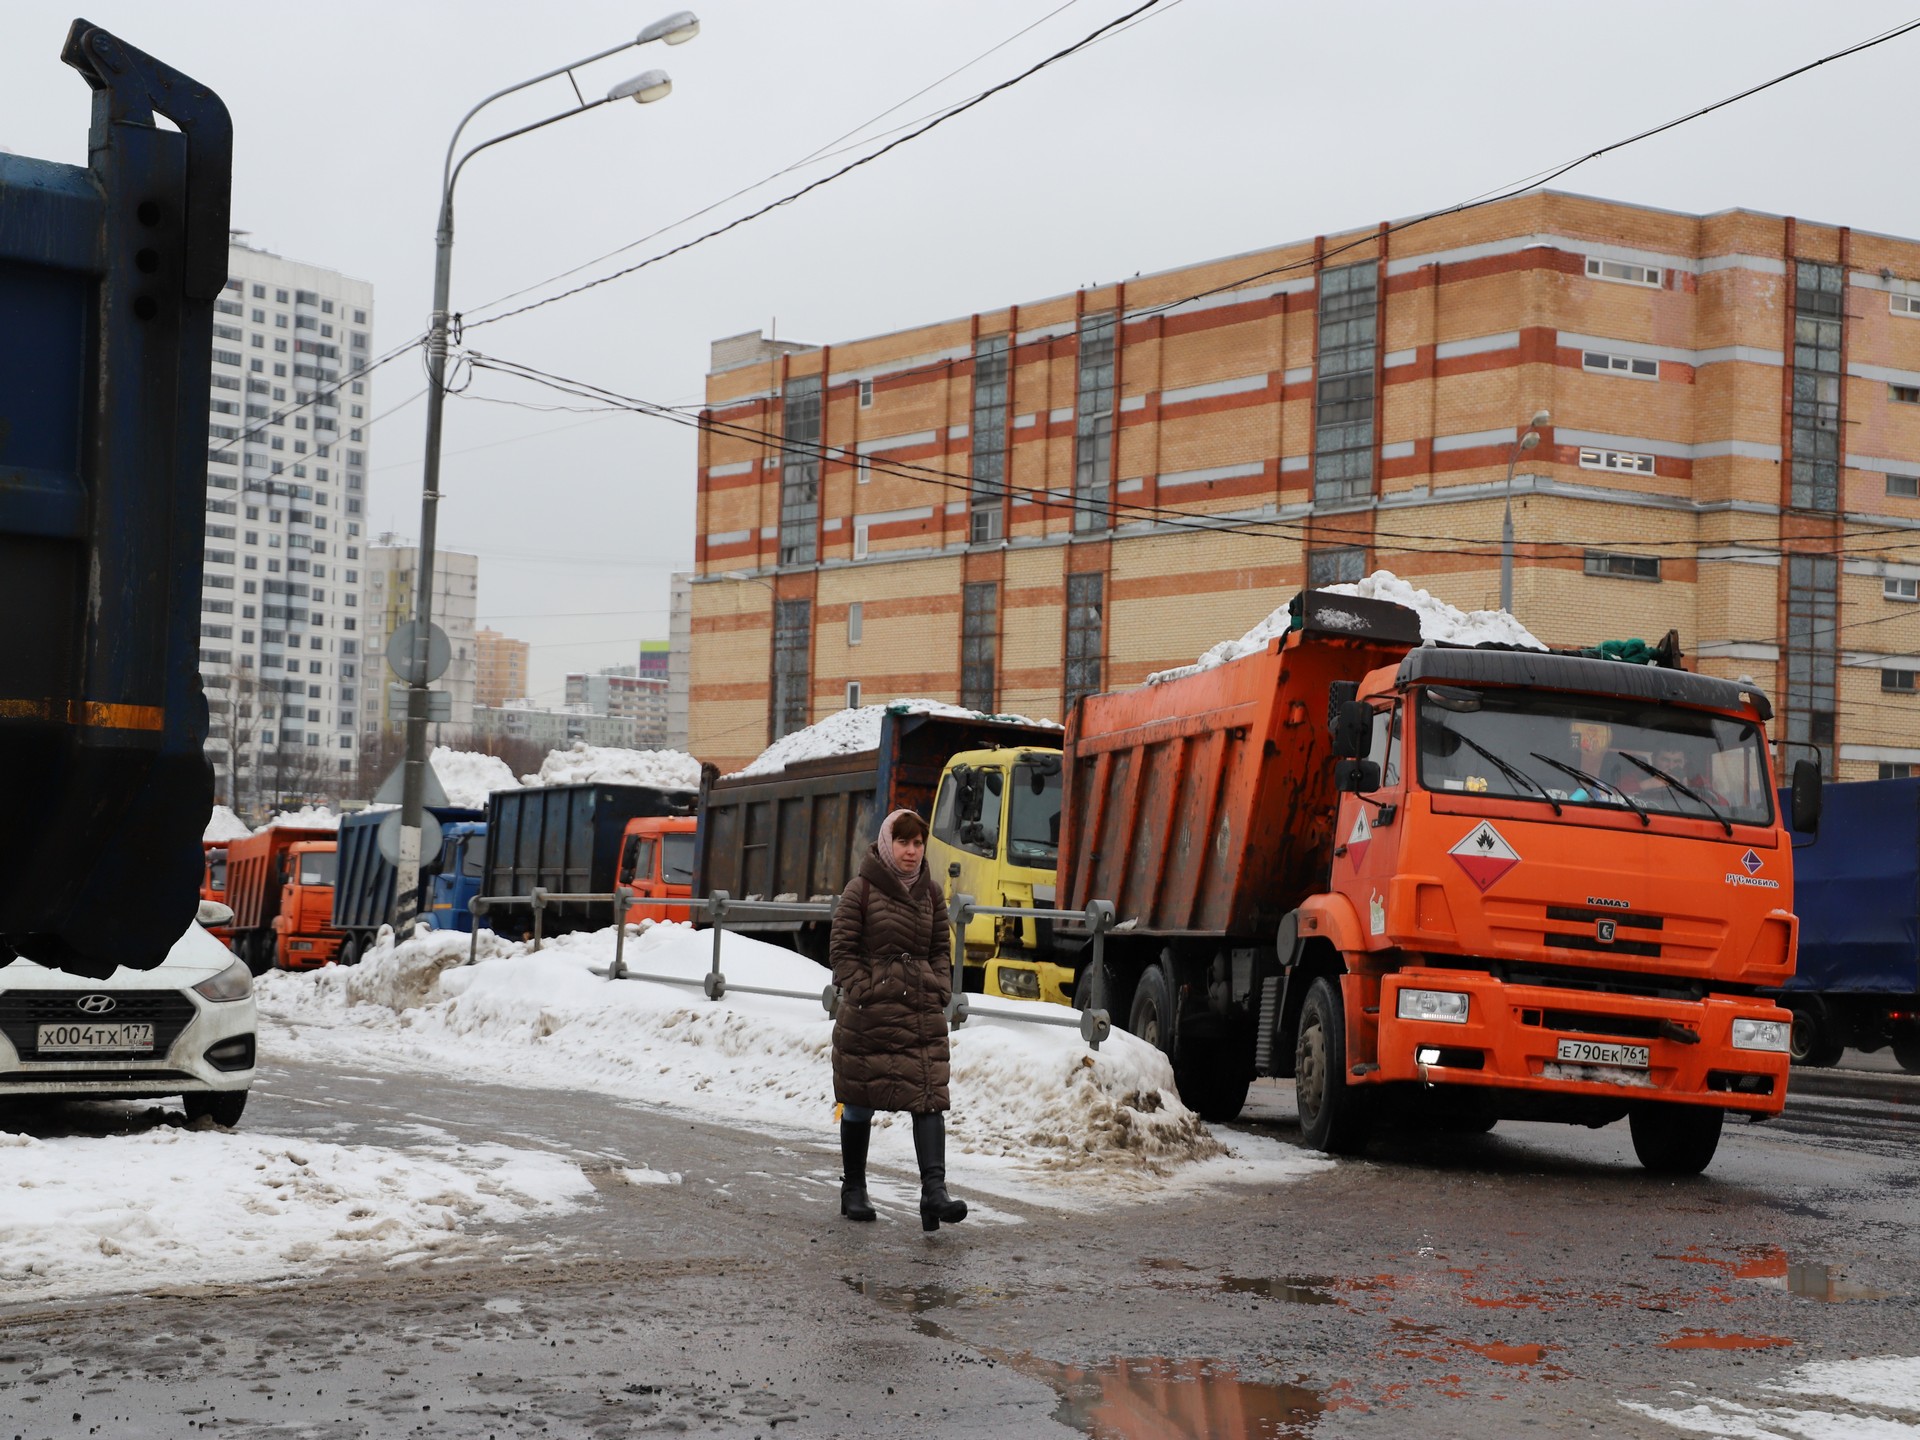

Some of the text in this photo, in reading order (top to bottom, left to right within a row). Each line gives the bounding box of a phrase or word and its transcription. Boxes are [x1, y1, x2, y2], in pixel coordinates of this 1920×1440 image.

[1587, 897, 1630, 908] КАМАЗ
[123, 1025, 150, 1039] 177
[1623, 1047, 1645, 1060] 761
